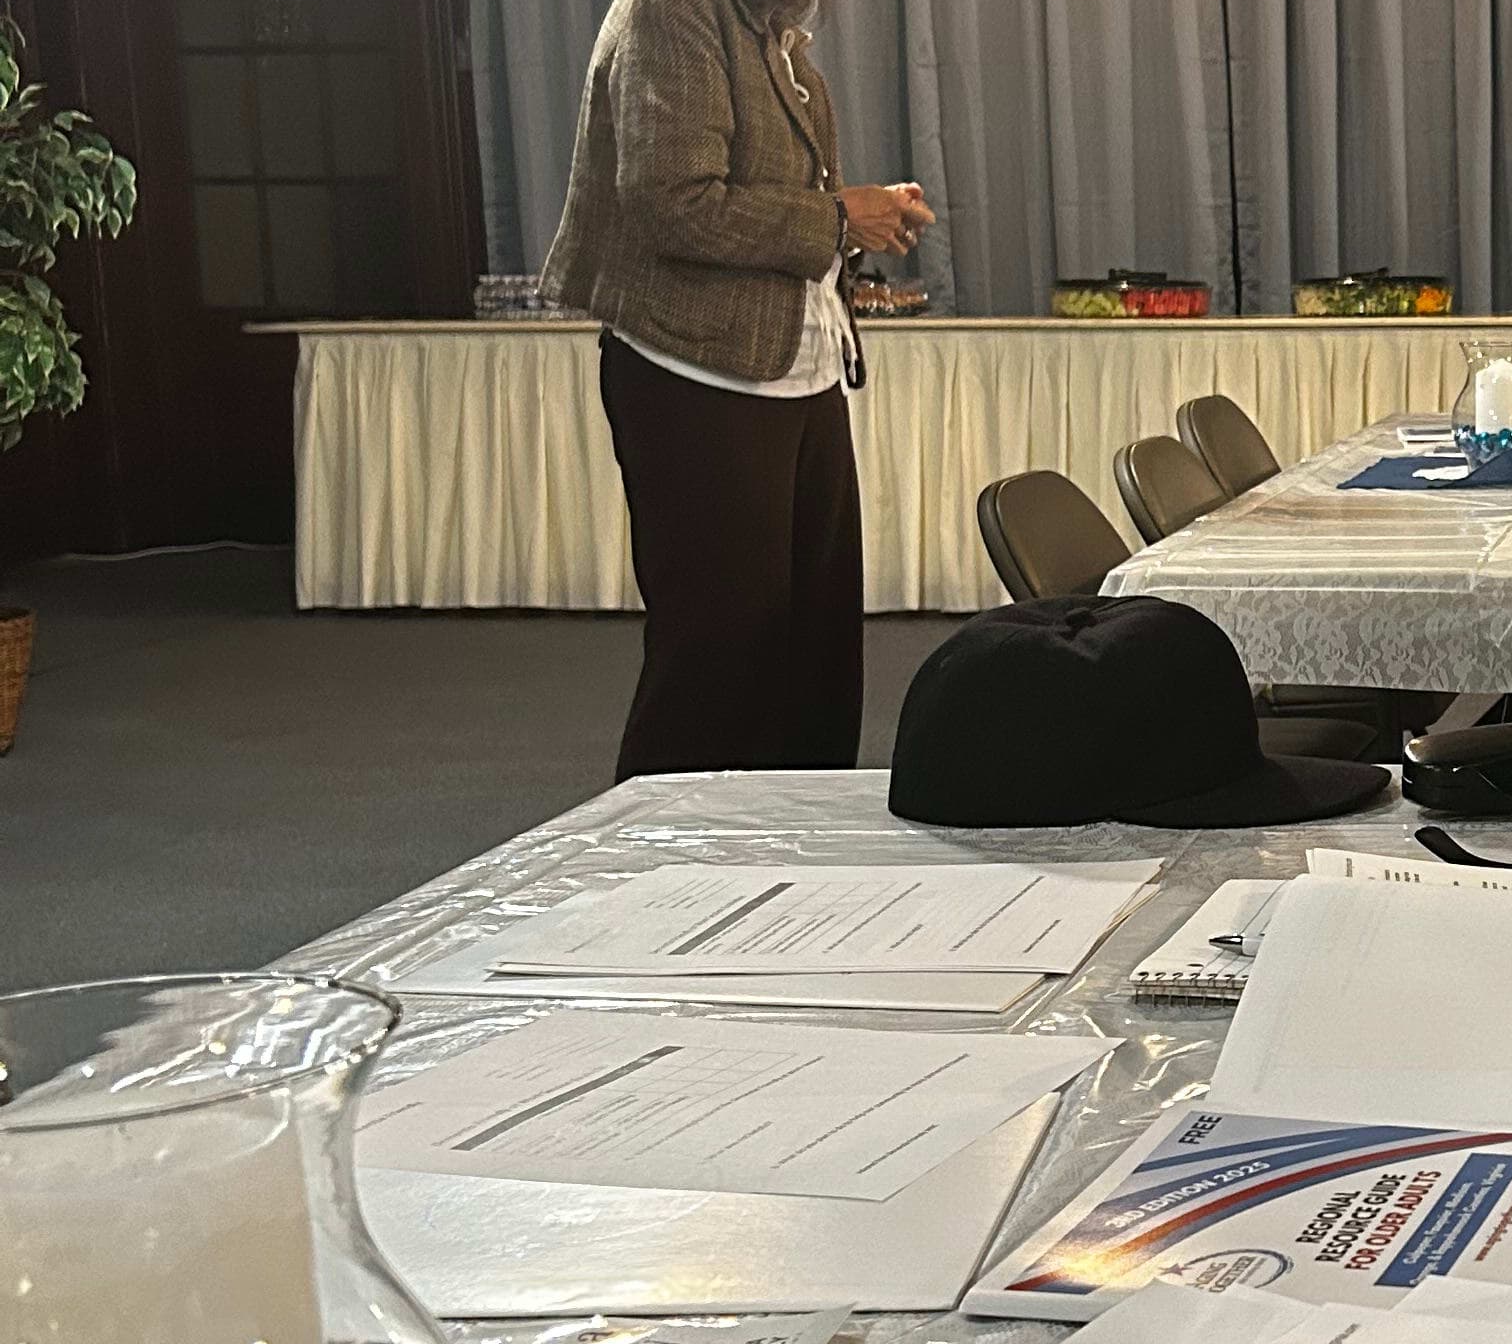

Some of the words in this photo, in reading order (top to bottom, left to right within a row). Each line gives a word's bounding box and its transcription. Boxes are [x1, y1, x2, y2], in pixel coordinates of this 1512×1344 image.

[1178, 1114, 1223, 1145] FREE
[1143, 1178, 1218, 1212] EDITION
[1213, 1161, 1271, 1183] 2025
[1295, 1190, 1361, 1244] REGIONAL
[1314, 1206, 1382, 1263] RESOURCE
[1363, 1173, 1407, 1205] GUIDE
[1344, 1247, 1384, 1270] FOR
[1364, 1211, 1413, 1246] OLDER
[1393, 1170, 1442, 1211] ADULTS
